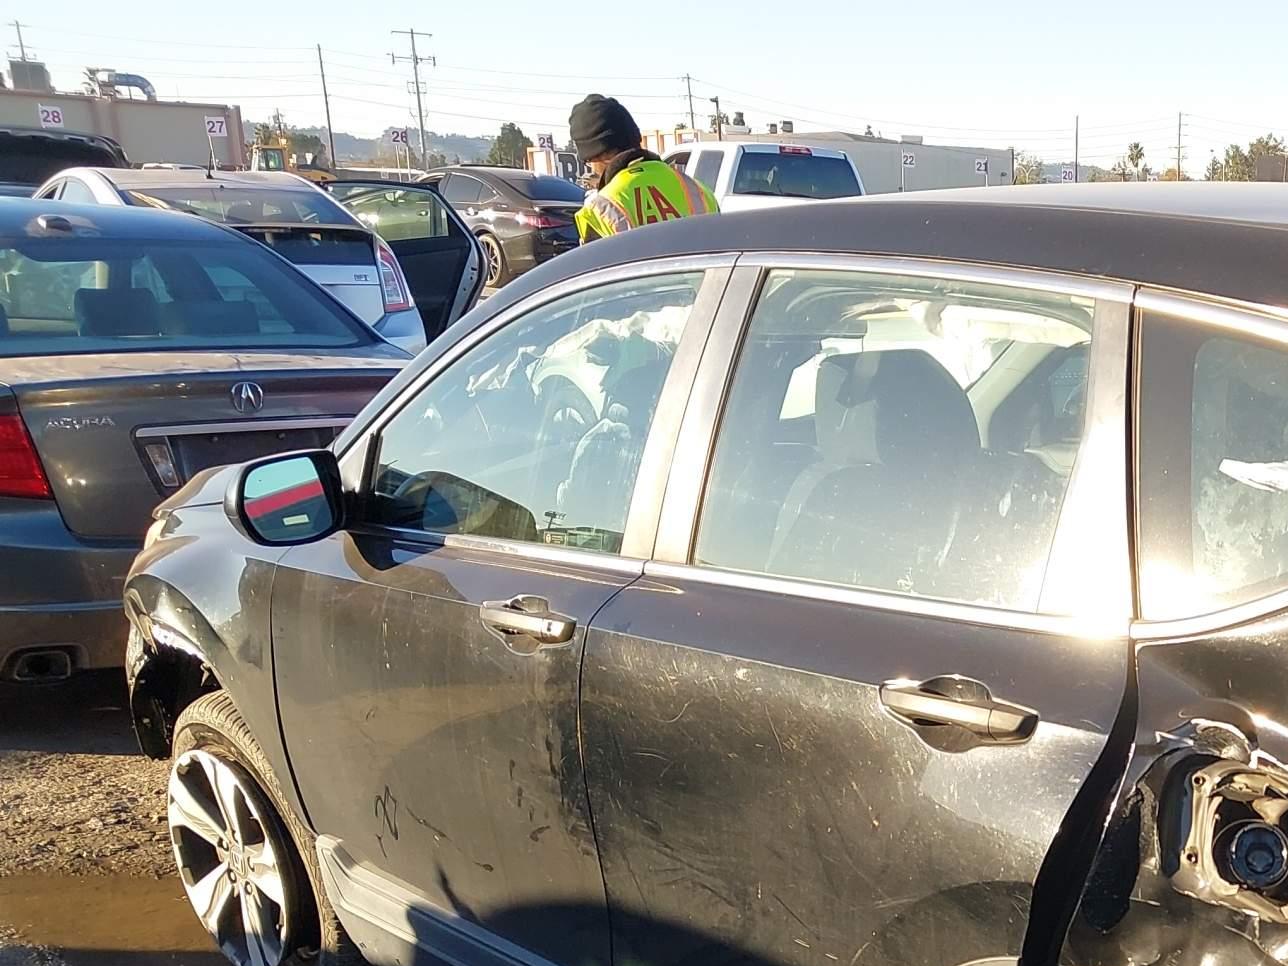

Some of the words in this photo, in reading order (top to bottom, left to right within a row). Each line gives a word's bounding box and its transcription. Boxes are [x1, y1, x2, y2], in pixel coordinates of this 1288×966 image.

[41, 109, 61, 123] 28
[207, 120, 224, 133] 27
[391, 130, 408, 143] 26
[903, 155, 914, 166] 22
[976, 161, 988, 172] 21
[1062, 171, 1073, 181] 20
